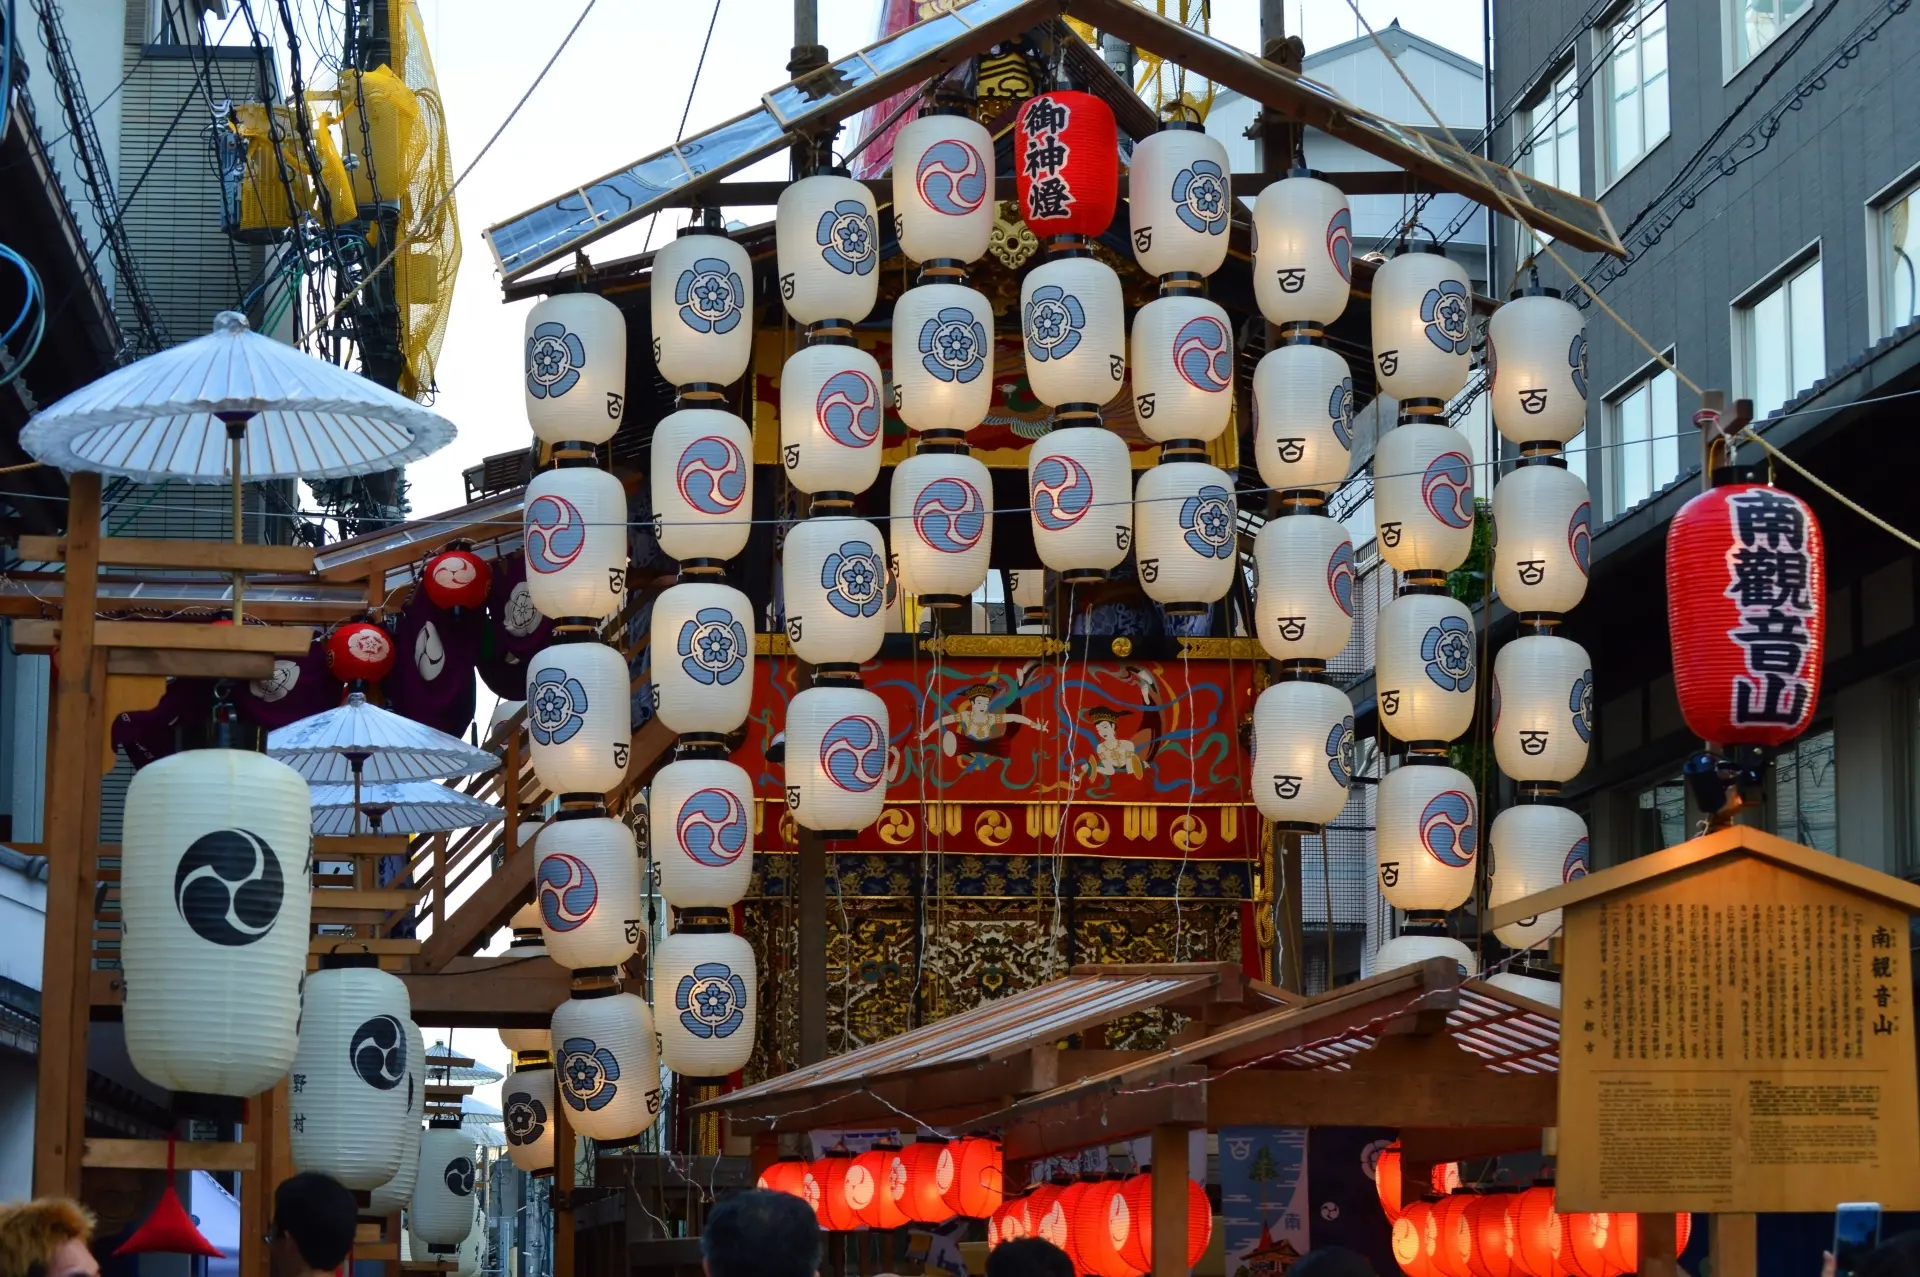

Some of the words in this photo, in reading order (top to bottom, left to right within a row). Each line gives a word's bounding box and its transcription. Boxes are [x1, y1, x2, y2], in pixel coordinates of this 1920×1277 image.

[1023, 97, 1075, 219] 御神燈
[1871, 925, 1893, 1036] 南観音山
[1584, 998, 1595, 1054] 京都市
[293, 1073, 307, 1134] 野村
